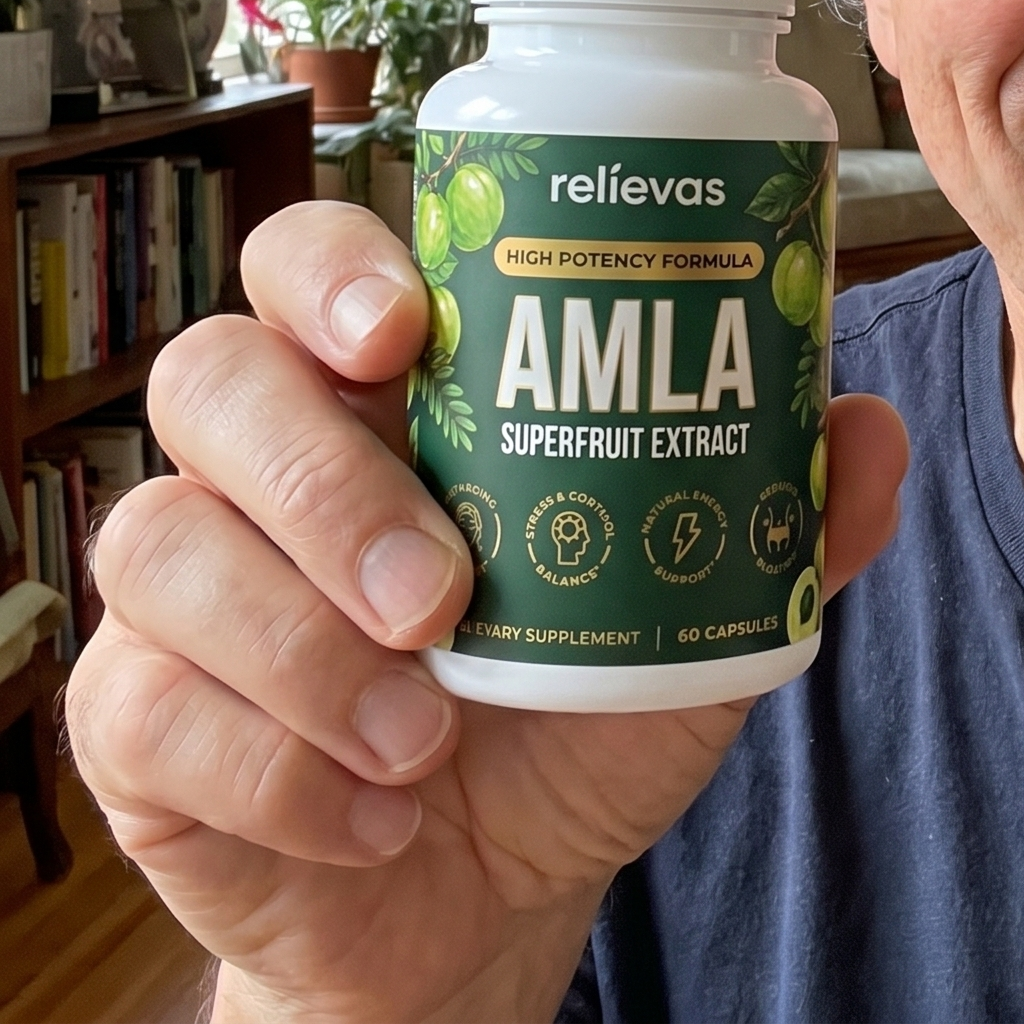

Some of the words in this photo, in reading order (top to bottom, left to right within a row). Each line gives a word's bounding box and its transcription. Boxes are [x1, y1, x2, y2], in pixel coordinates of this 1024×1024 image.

[506, 249, 553, 266] HIGH
[559, 251, 657, 269] POTENCY
[662, 253, 754, 269] FORMULA
[495, 294, 756, 413] AMLA
[501, 422, 645, 459] SUPERFRUIT
[651, 423, 751, 459] EXTRACT
[525, 495, 555, 540] STRESS
[640, 489, 691, 534] NATURAL
[525, 628, 641, 646] SUPPLEMENT
[677, 628, 701, 644] 60
[704, 615, 779, 641] CAPSULES
